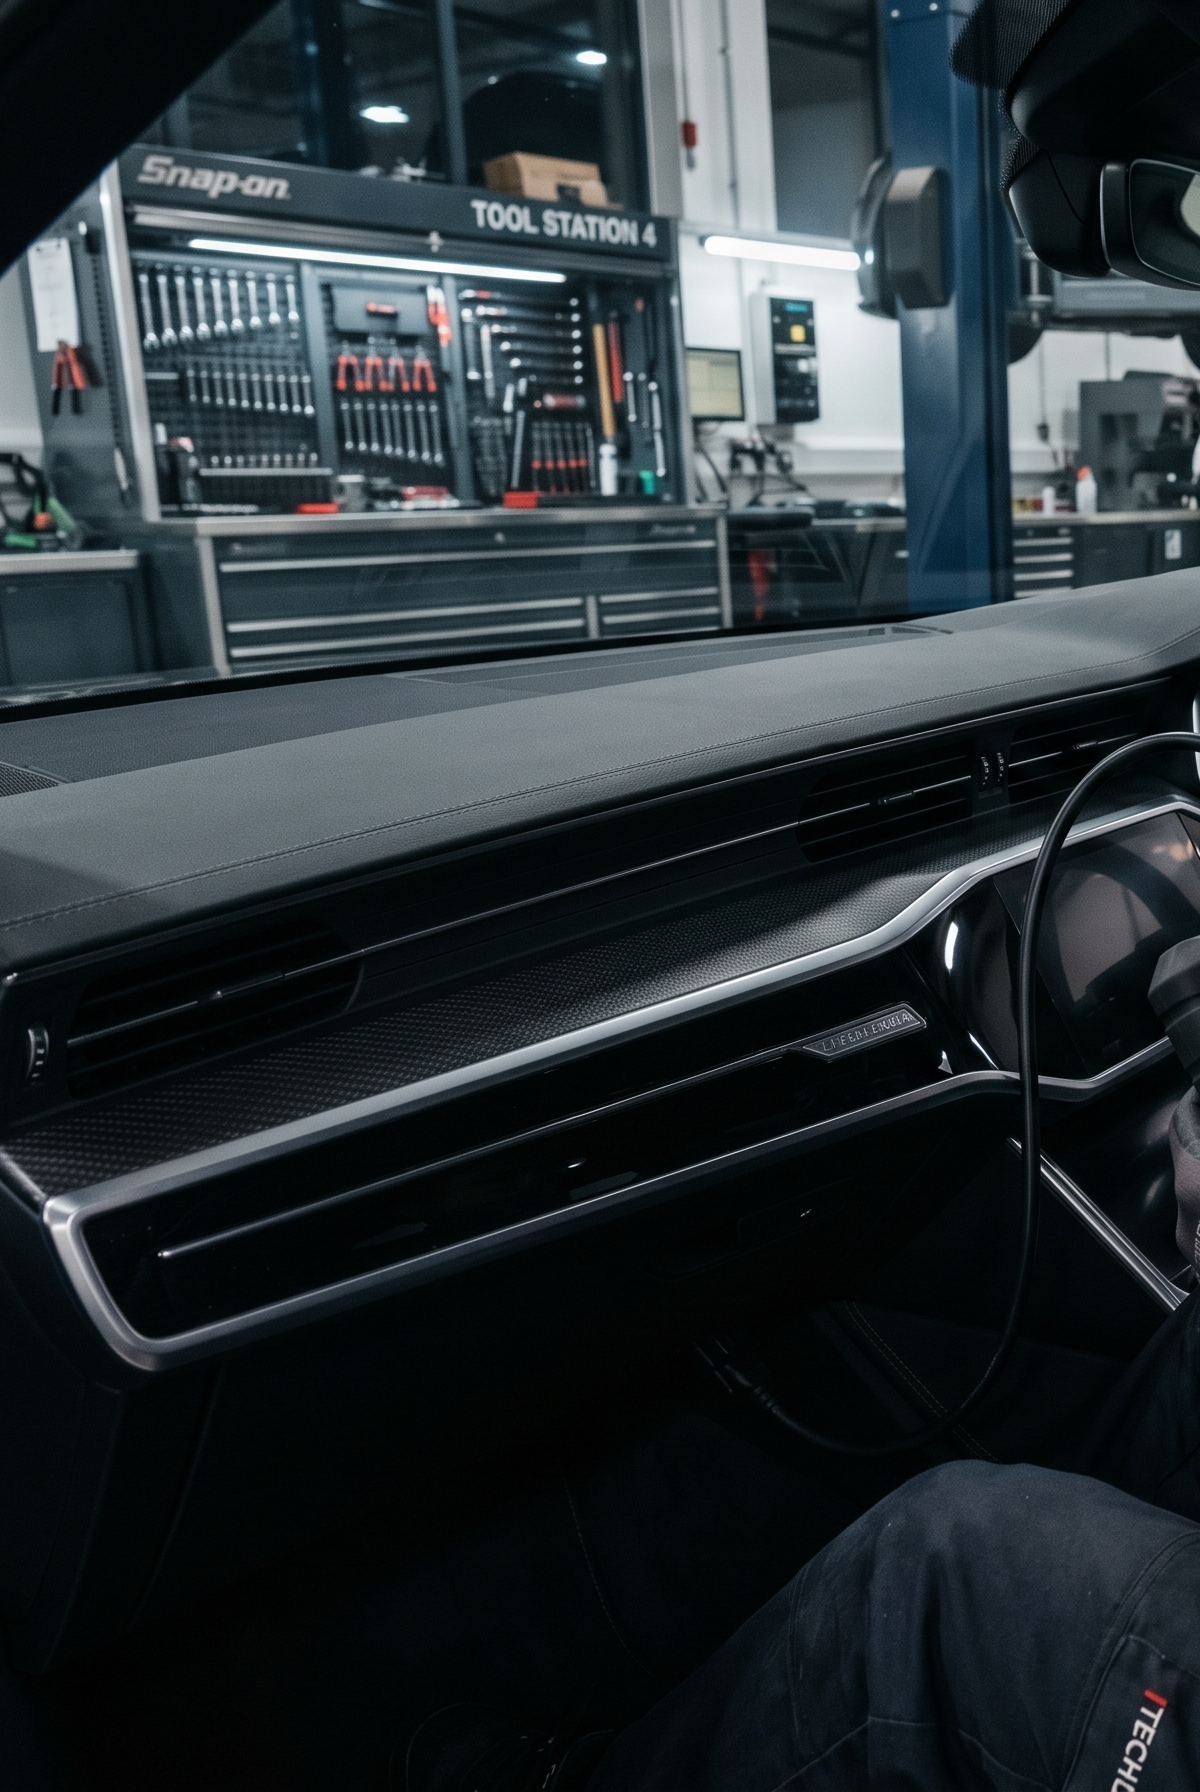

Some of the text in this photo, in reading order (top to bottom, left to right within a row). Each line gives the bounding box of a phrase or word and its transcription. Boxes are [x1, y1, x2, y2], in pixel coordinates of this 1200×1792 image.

[136, 153, 290, 200] Snap-on
[470, 199, 658, 249] TOOL STATION 4
